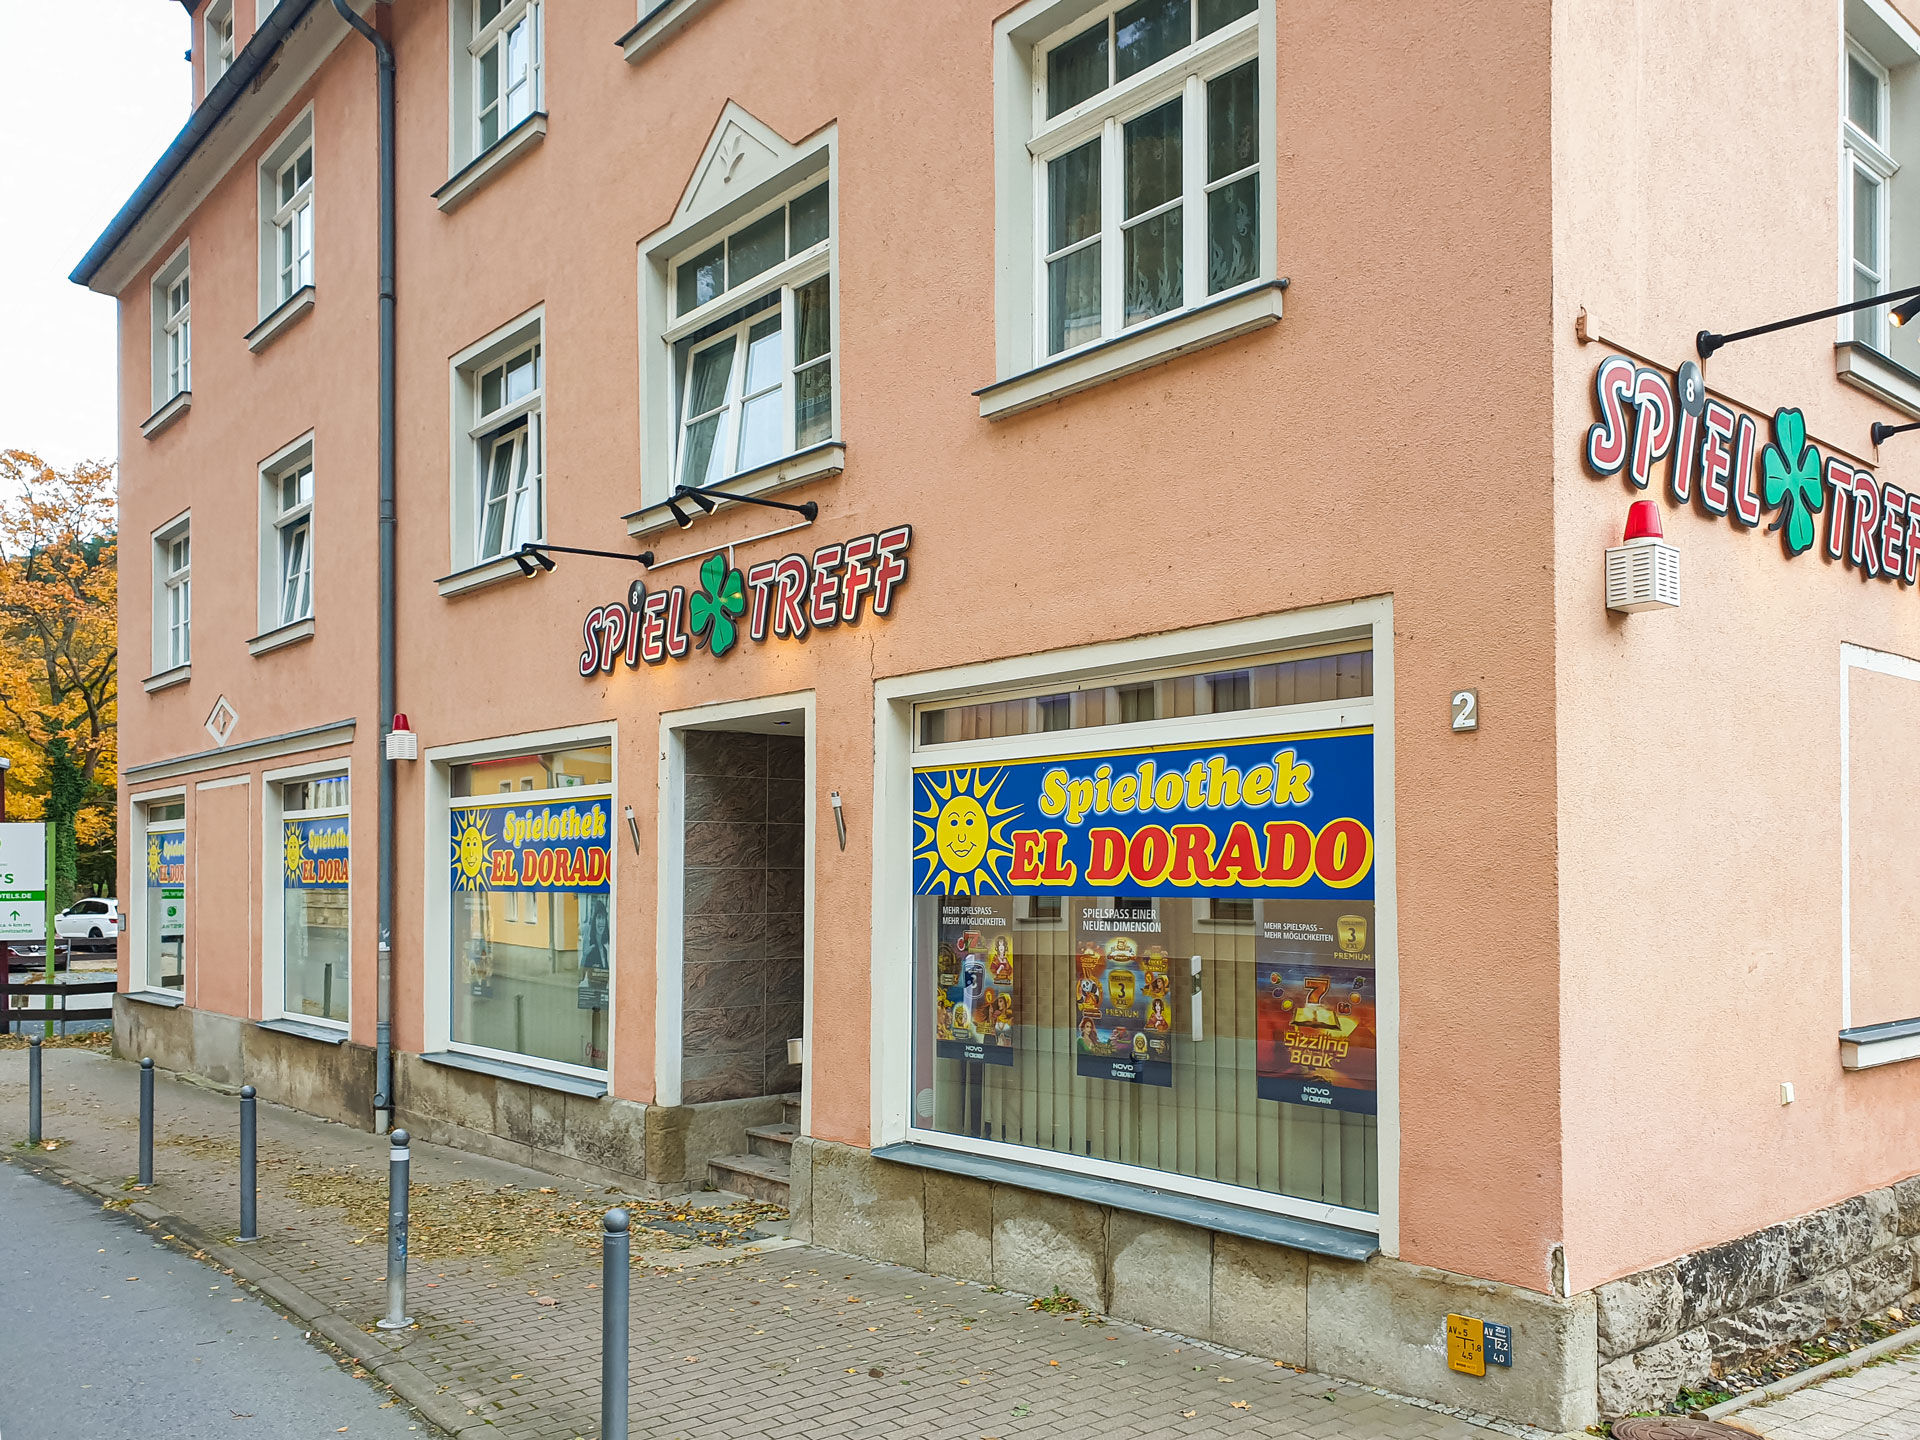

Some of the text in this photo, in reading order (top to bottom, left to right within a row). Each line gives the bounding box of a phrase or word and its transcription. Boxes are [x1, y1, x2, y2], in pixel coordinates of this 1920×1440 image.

[1588, 355, 1760, 527] SPIEL
[579, 524, 913, 677] SPIEL TREFF
[1453, 691, 1476, 728] 2
[1040, 749, 1312, 825] Spielothek
[503, 804, 606, 848] Spielothek
[1007, 818, 1373, 888] EL DORADO
[302, 859, 316, 883] EL
[490, 847, 612, 886] EL DORAD
[942, 906, 960, 915] MEHR
[960, 906, 992, 915] SPIELSPASS
[1082, 908, 1156, 920] SPIELSPASS EINER
[942, 917, 960, 925] MEHR
[1082, 921, 1162, 933] NEUEN DIMENSION
[1264, 922, 1282, 930] MEHR
[1283, 923, 1317, 932] SPIELSPASS
[1264, 931, 1334, 942] MEHR MÖGLICHKEITEN
[1347, 927, 1357, 943] 3
[1334, 952, 1371, 961] PREMIUM
[1117, 983, 1126, 998] 3
[1105, 1008, 1139, 1018] PREMIUM
[1284, 1032, 1349, 1058] Sizzling
[1290, 1049, 1334, 1068] Book
[1112, 1063, 1134, 1071] NOVO
[1303, 1086, 1330, 1096] NOVO
[1484, 1327, 1494, 1336] AV
